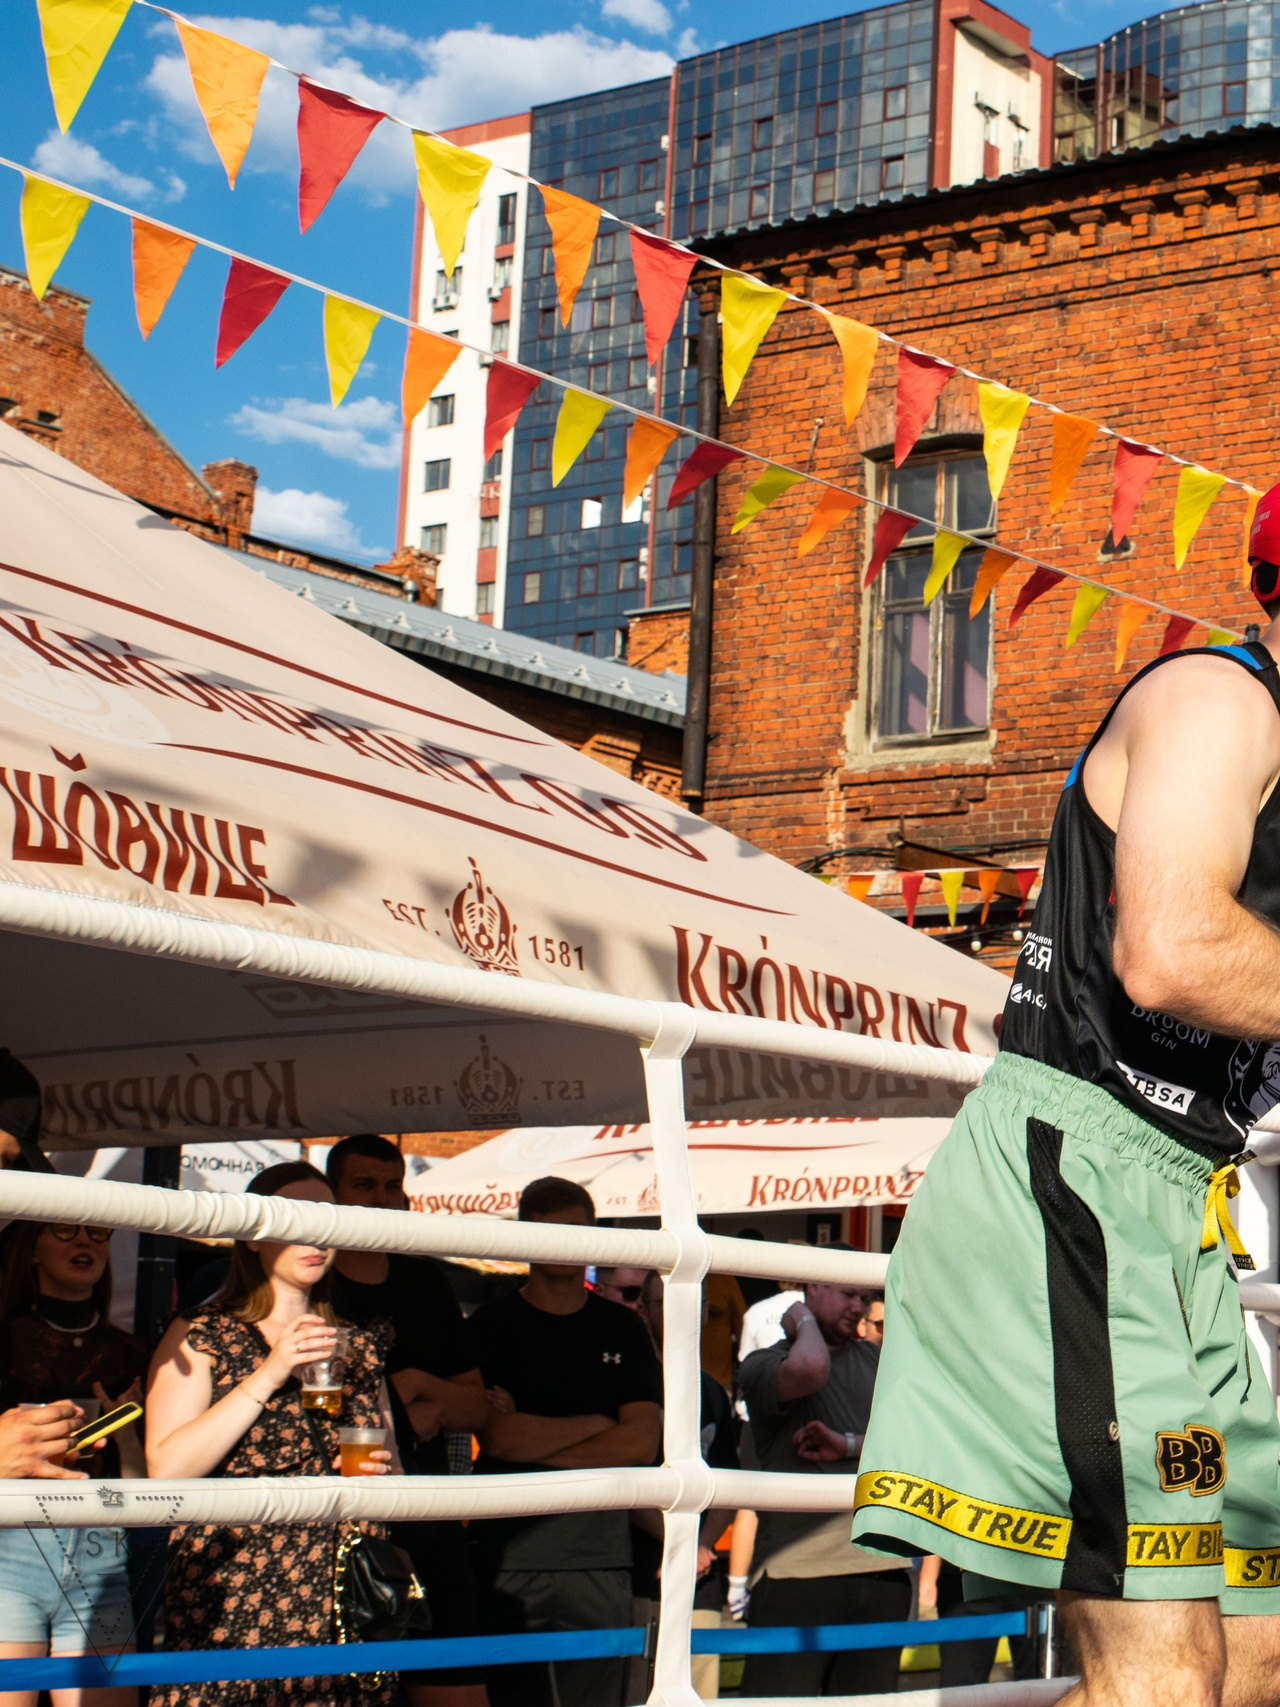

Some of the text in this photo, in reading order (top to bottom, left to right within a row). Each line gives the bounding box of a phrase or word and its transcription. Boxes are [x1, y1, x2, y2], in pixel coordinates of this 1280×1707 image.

[382, 899, 585, 971] EST. 1581
[668, 925, 971, 1054] KRÓNPRINZ
[1151, 1032, 1178, 1051] GIN
[868, 1476, 1062, 1552] STAY TRUE
[1131, 1530, 1192, 1560] TAY
